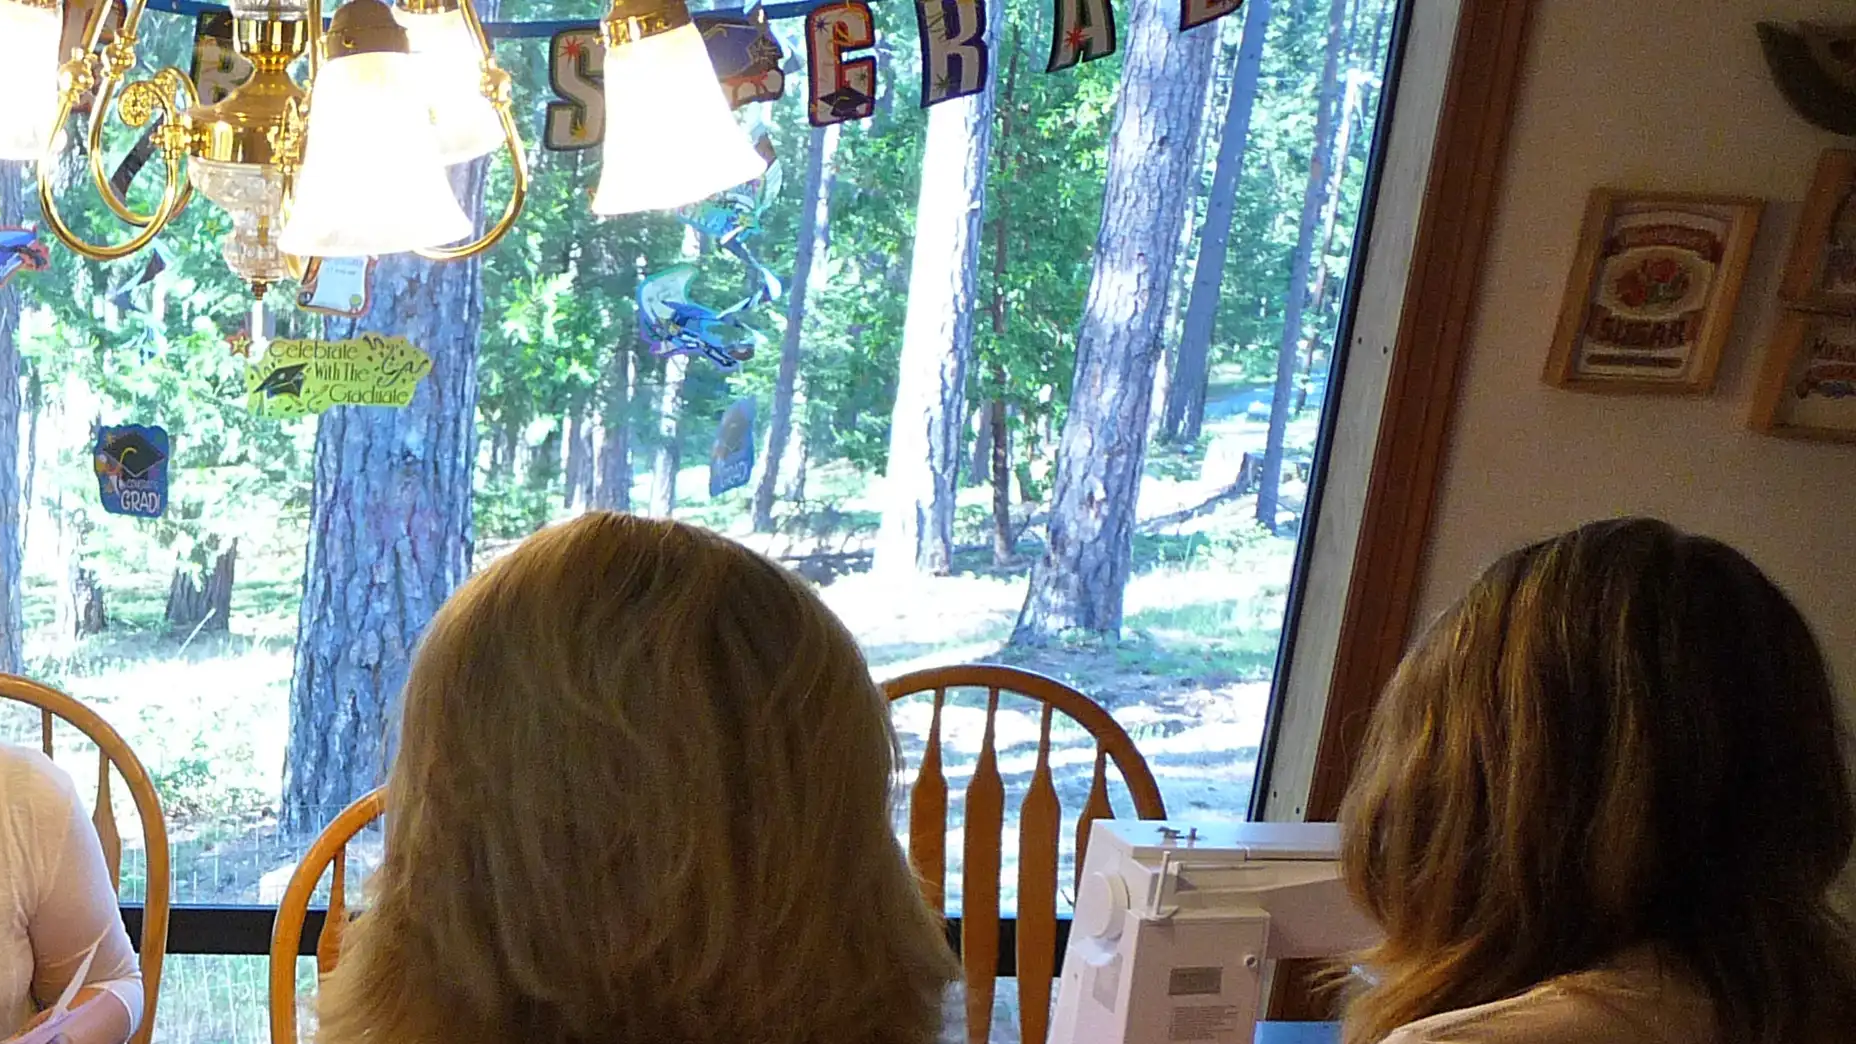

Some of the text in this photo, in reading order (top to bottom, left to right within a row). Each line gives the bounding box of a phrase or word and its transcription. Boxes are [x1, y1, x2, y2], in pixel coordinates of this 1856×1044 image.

[268, 340, 359, 360] Celebrate
[314, 362, 370, 382] With The
[329, 383, 409, 404] Graduate
